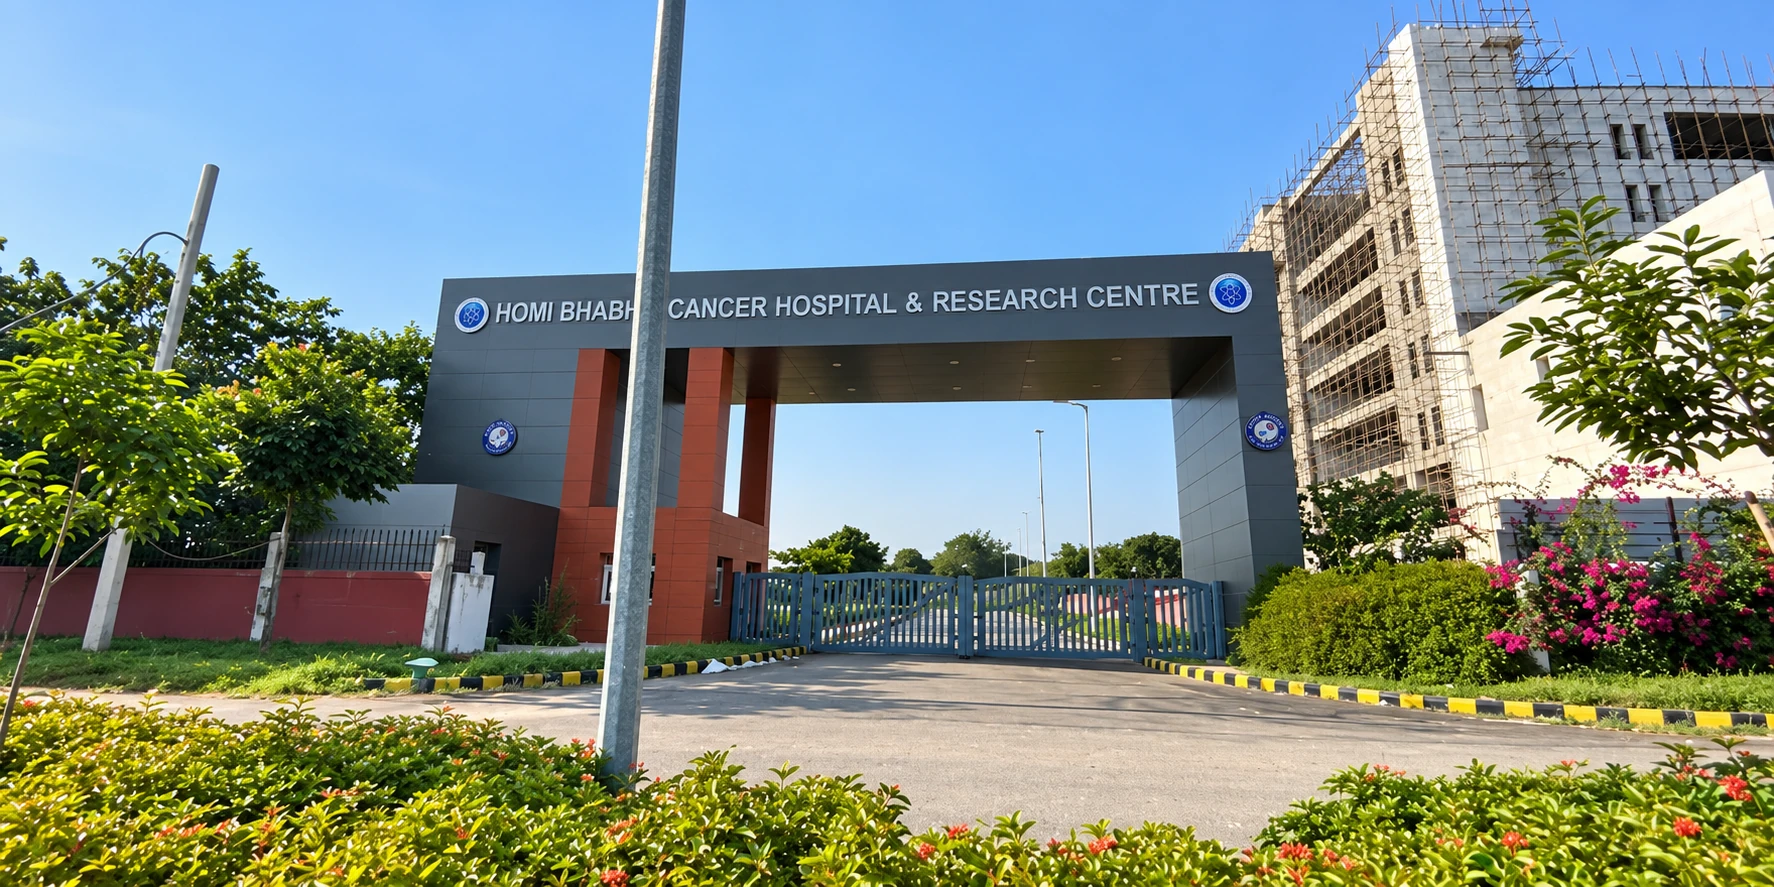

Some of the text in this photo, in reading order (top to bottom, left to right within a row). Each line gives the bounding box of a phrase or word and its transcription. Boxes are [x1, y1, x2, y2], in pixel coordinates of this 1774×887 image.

[495, 302, 552, 323] HOMI
[560, 300, 635, 321] BHABH
[668, 297, 767, 319] CANCER
[775, 293, 897, 317] HOSPITAL
[905, 291, 923, 313] &
[933, 286, 1077, 312] RESEARCH
[1086, 283, 1200, 308] CENTRE
